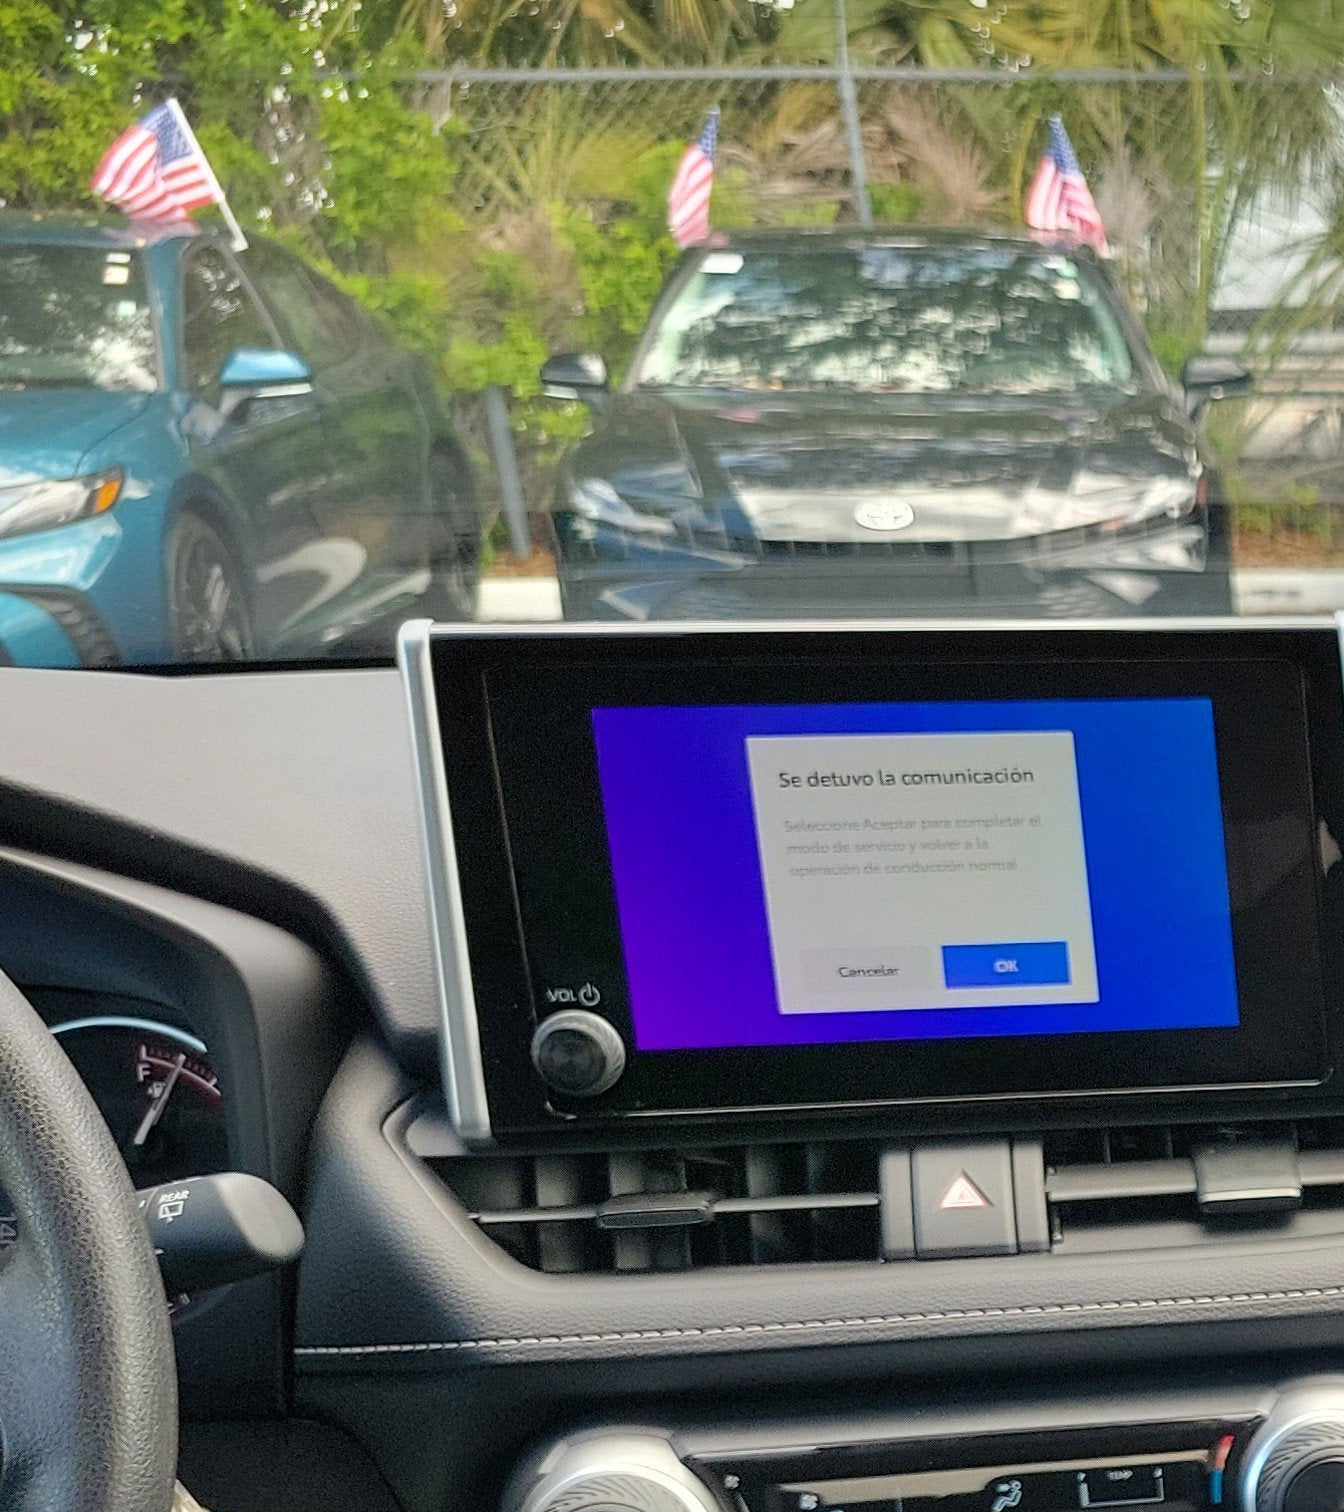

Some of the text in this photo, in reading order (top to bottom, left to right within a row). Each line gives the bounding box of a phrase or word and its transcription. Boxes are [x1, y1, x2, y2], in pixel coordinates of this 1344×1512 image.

[779, 769, 1035, 788] Se detuvo la comunicación
[863, 818, 917, 834] Aceptar
[921, 817, 952, 831] para
[787, 841, 831, 855] modo
[837, 964, 900, 978] Cancelar
[993, 960, 1019, 973] OK
[546, 987, 577, 1003] VOL
[158, 1189, 190, 1204] REAR
